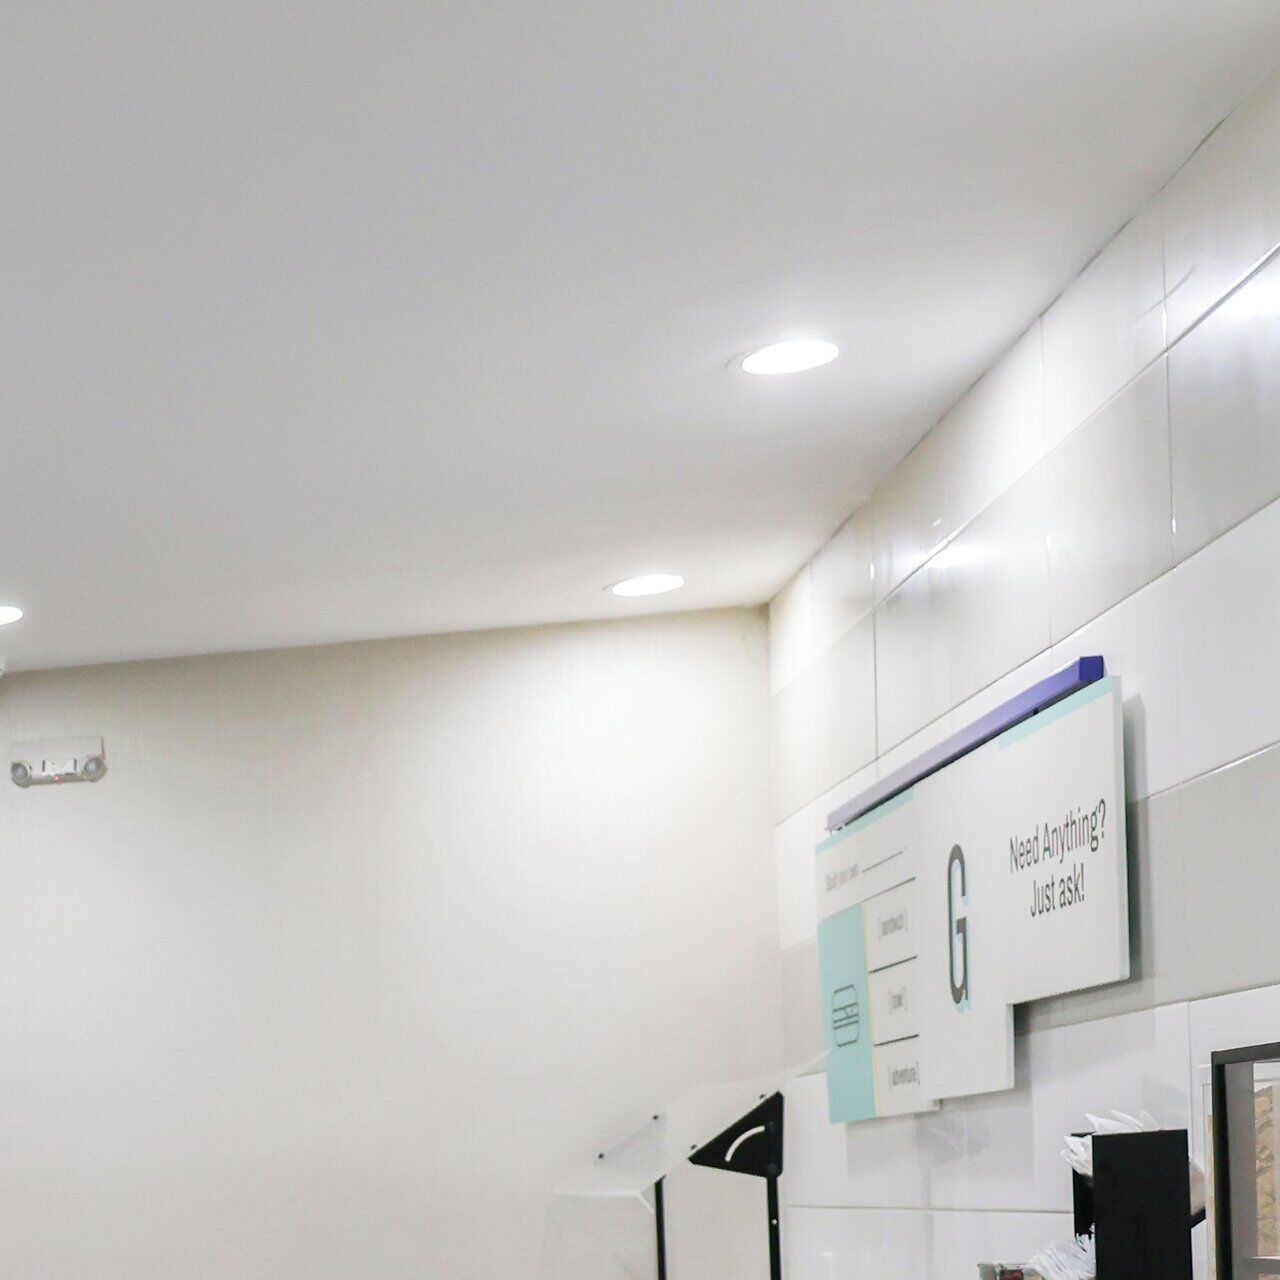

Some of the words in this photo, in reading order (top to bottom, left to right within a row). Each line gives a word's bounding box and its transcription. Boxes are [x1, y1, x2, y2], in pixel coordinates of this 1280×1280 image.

[1010, 825, 1040, 874] Need
[1042, 798, 1106, 864] Anything?
[947, 843, 969, 1005] G
[1031, 874, 1055, 918] Just
[1059, 863, 1085, 907] ask!
